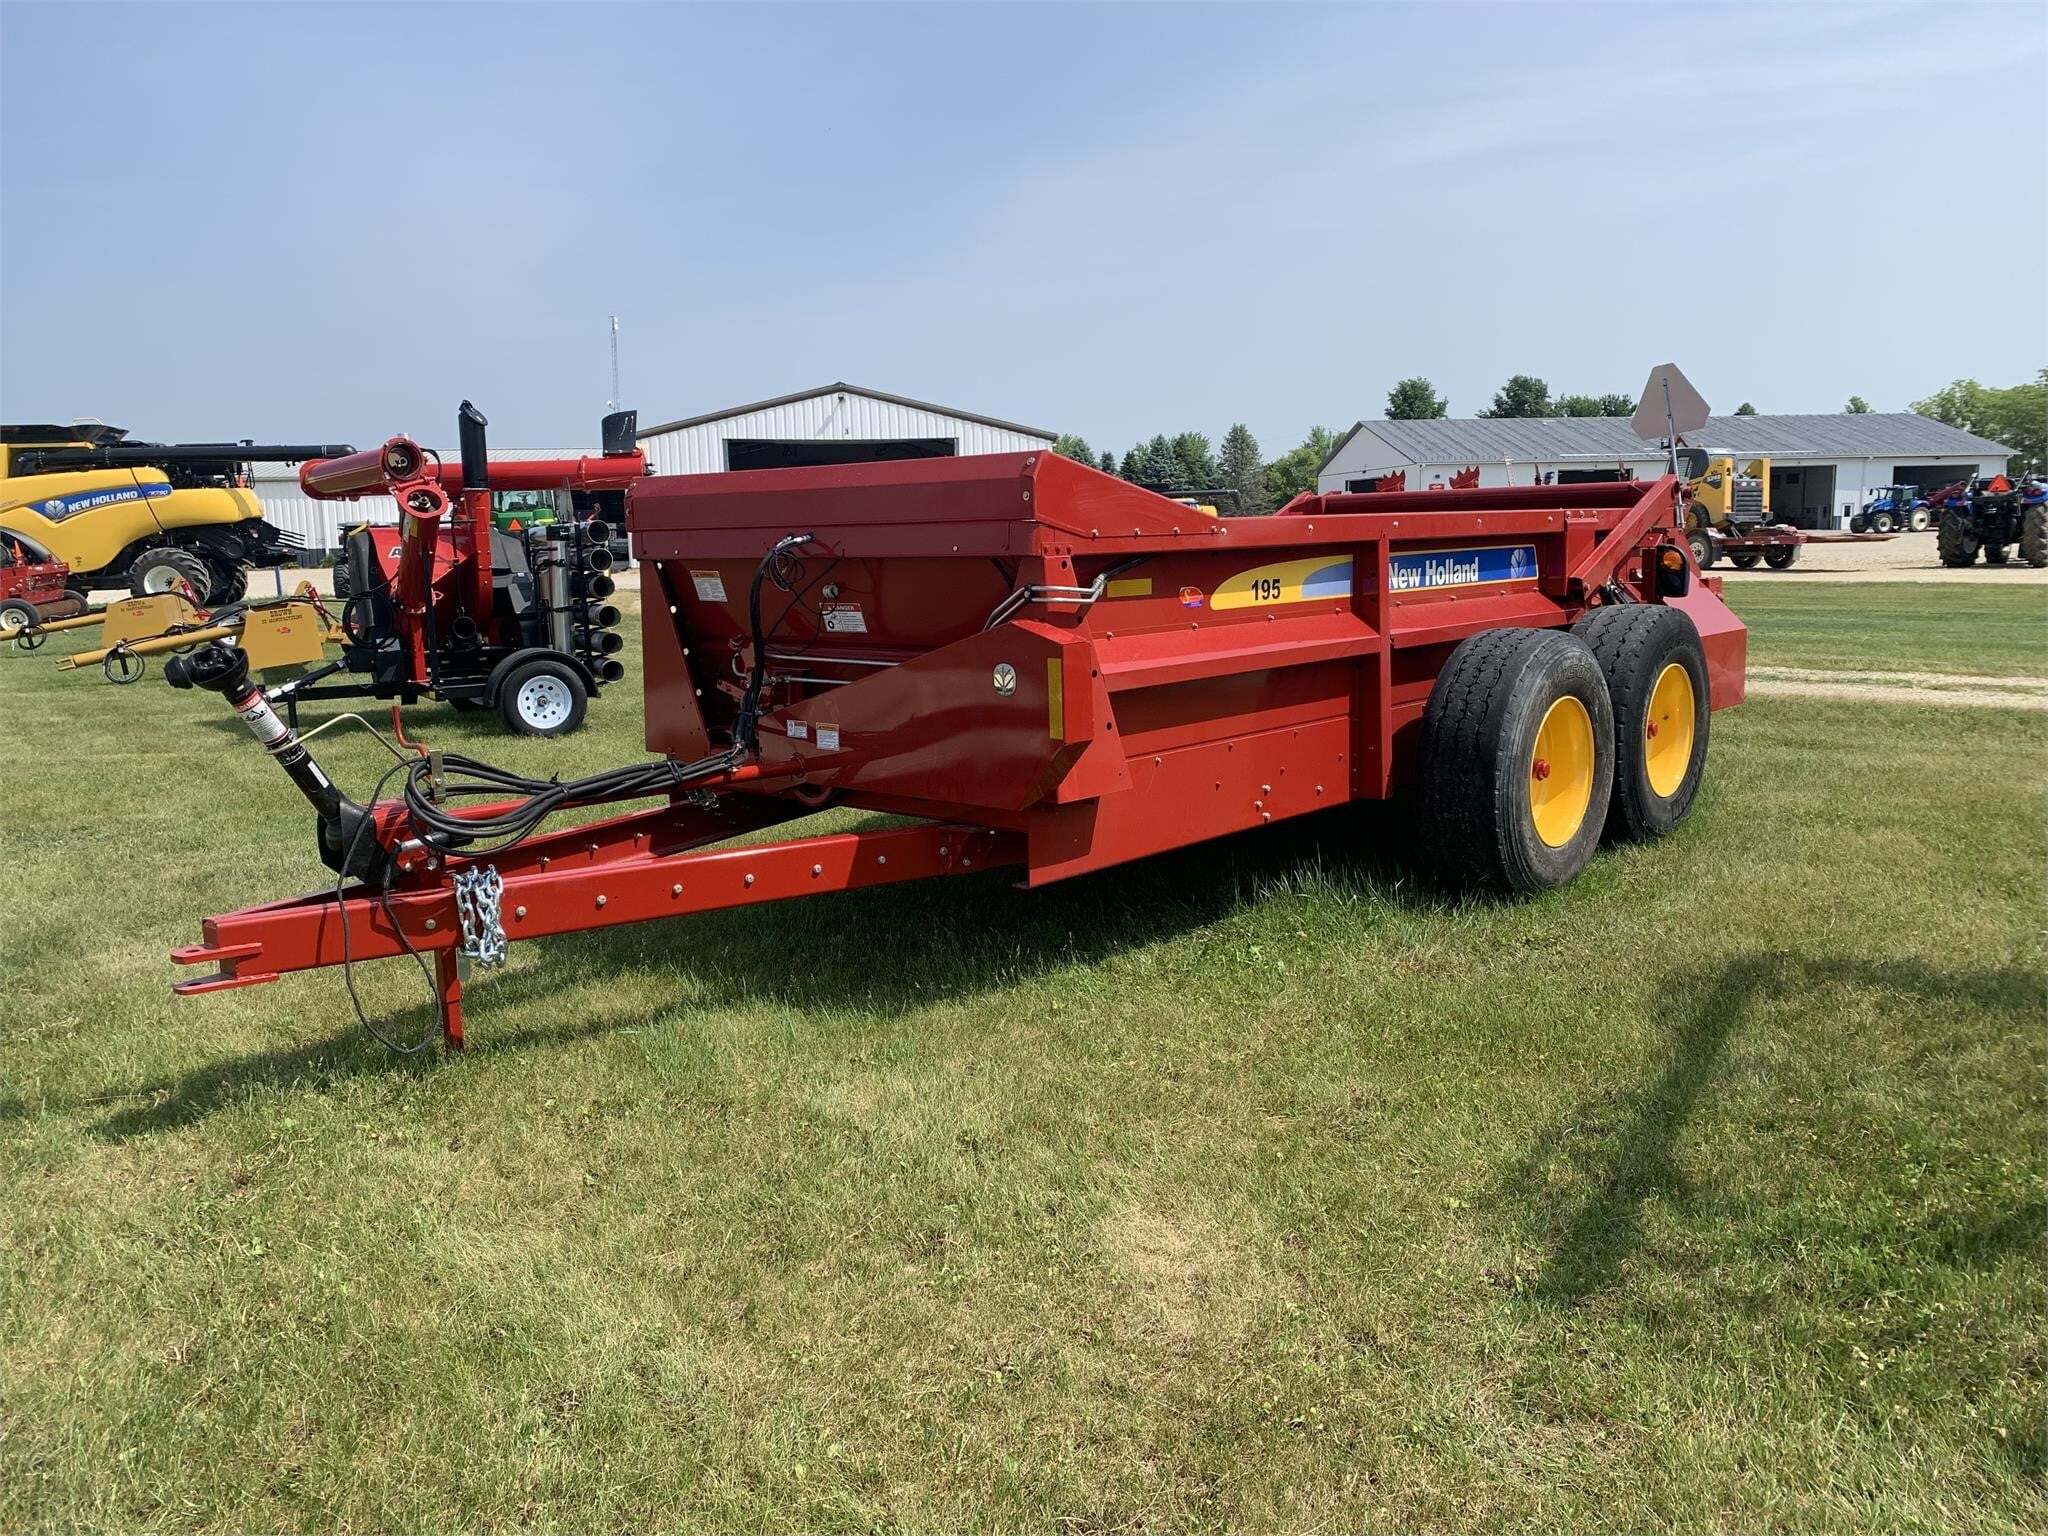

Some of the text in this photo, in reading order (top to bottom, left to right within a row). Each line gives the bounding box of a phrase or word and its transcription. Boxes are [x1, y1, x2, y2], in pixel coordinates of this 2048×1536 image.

[68, 490, 138, 513] NEW HOLLAND
[1388, 557, 1479, 589] New Holland
[1250, 578, 1281, 601] 195
